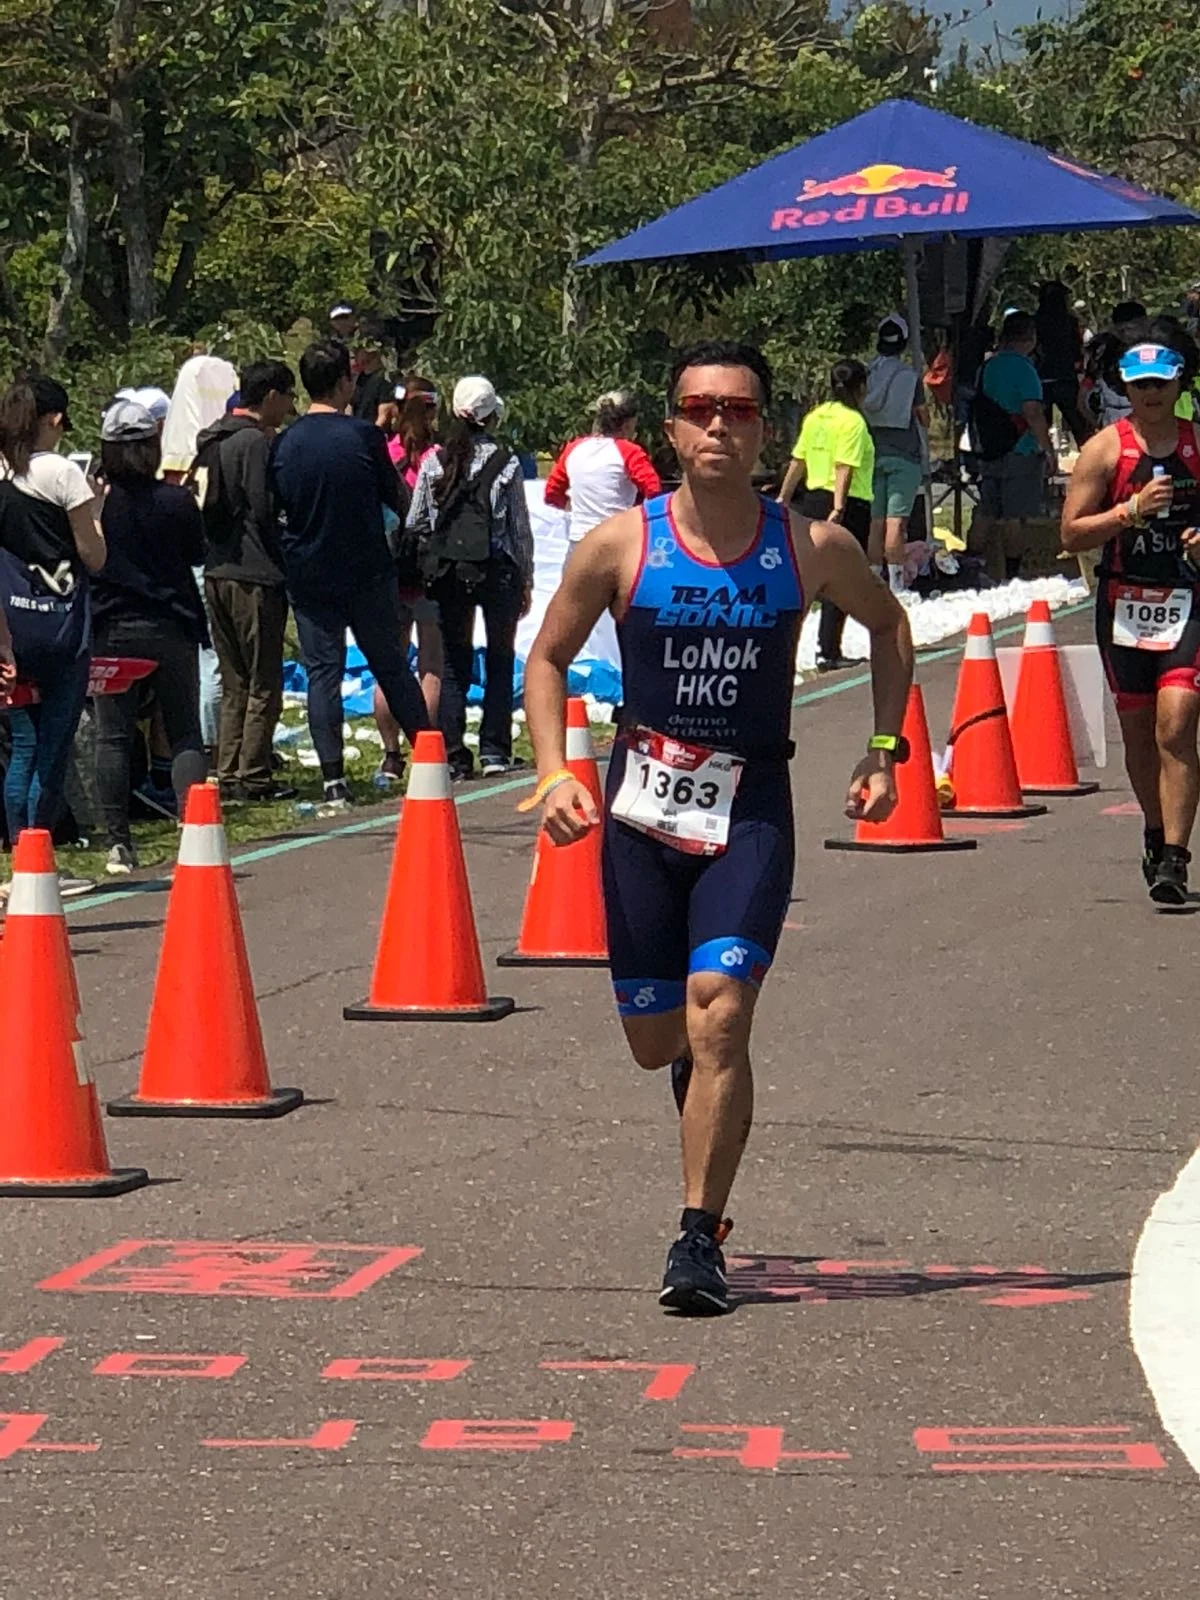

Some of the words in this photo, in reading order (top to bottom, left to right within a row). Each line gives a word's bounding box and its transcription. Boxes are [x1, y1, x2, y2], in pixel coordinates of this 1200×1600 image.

[769, 198, 868, 231] Red
[873, 191, 969, 218] Bull
[671, 584, 768, 609] TEAM
[655, 604, 777, 628] SONIC
[1126, 603, 1181, 624] 1085
[663, 637, 761, 670] LoNok
[675, 674, 738, 707] HKG
[640, 763, 720, 810] 1363
